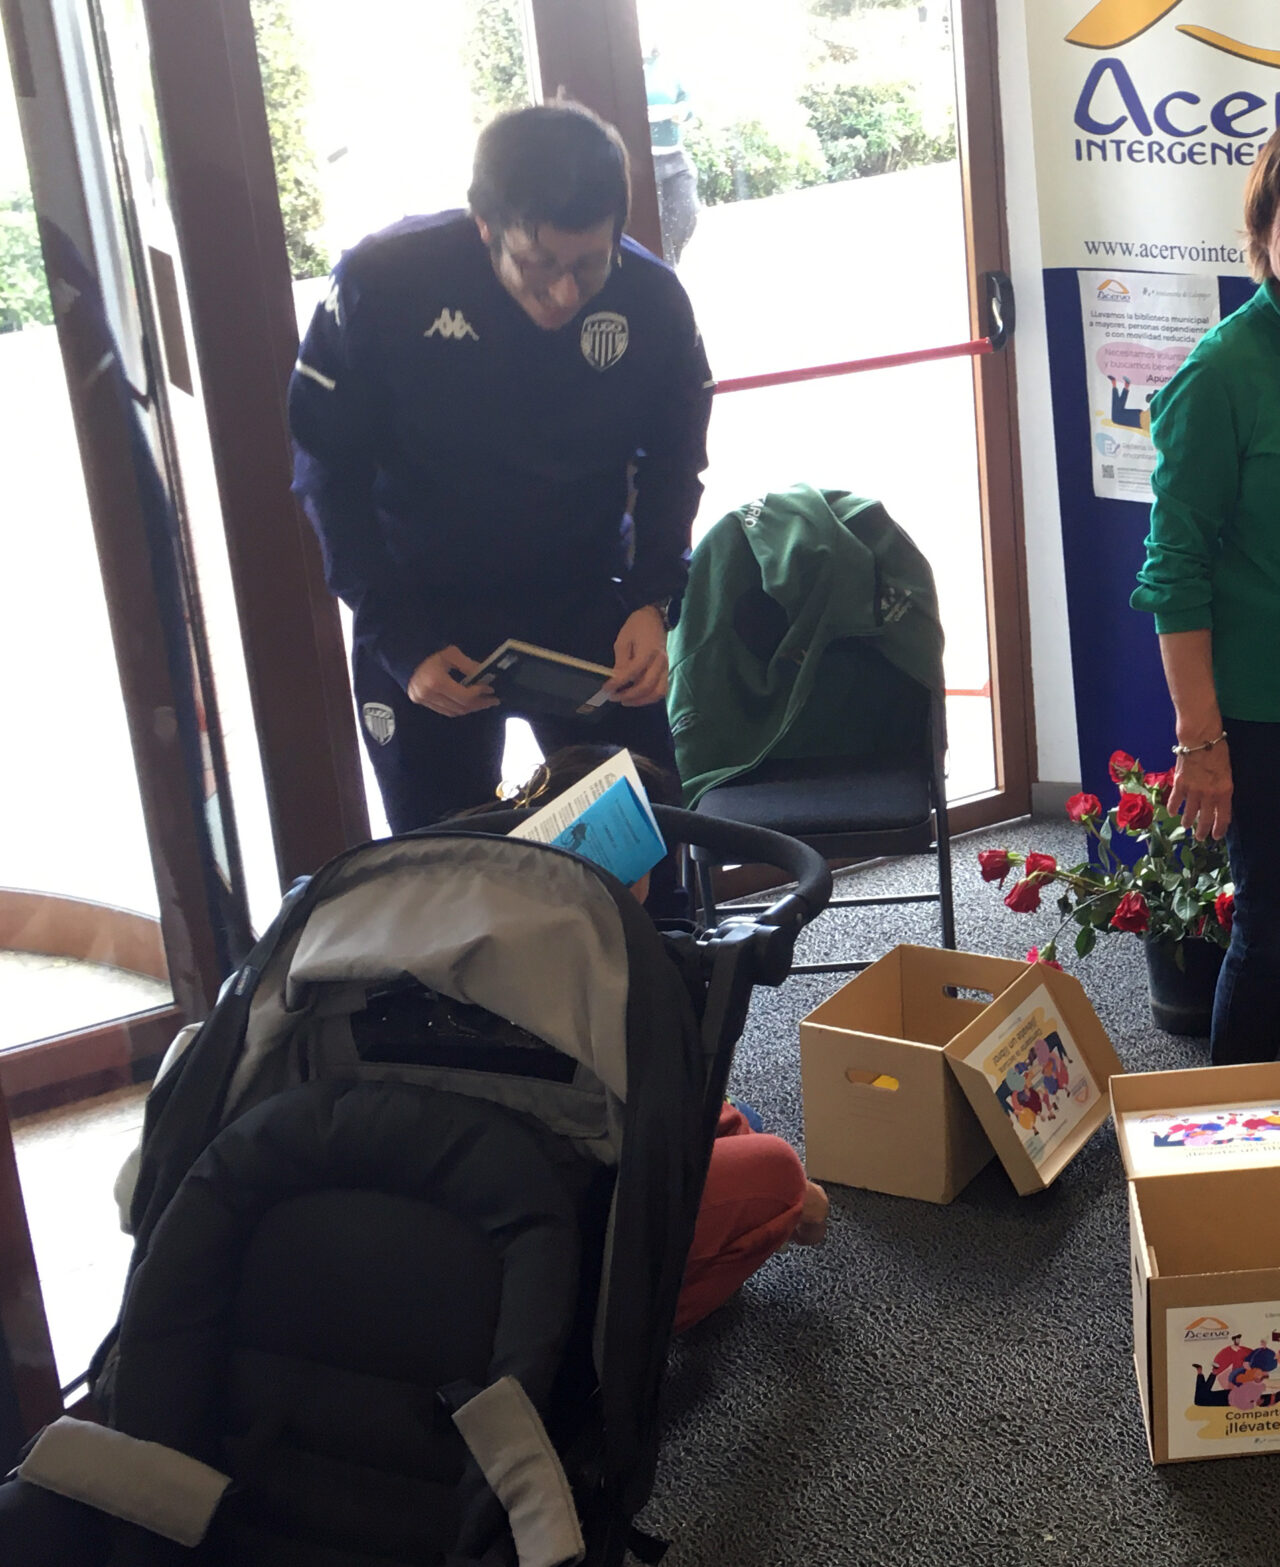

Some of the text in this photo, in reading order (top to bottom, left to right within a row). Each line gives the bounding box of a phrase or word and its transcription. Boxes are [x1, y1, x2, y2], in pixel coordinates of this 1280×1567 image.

[1134, 312, 1170, 322] biblioteca
[1171, 315, 1209, 325] municipal
[1126, 332, 1162, 340] movilidad
[1184, 1329, 1230, 1340] Acervo
[1225, 1420, 1280, 1436] ¡llévate
